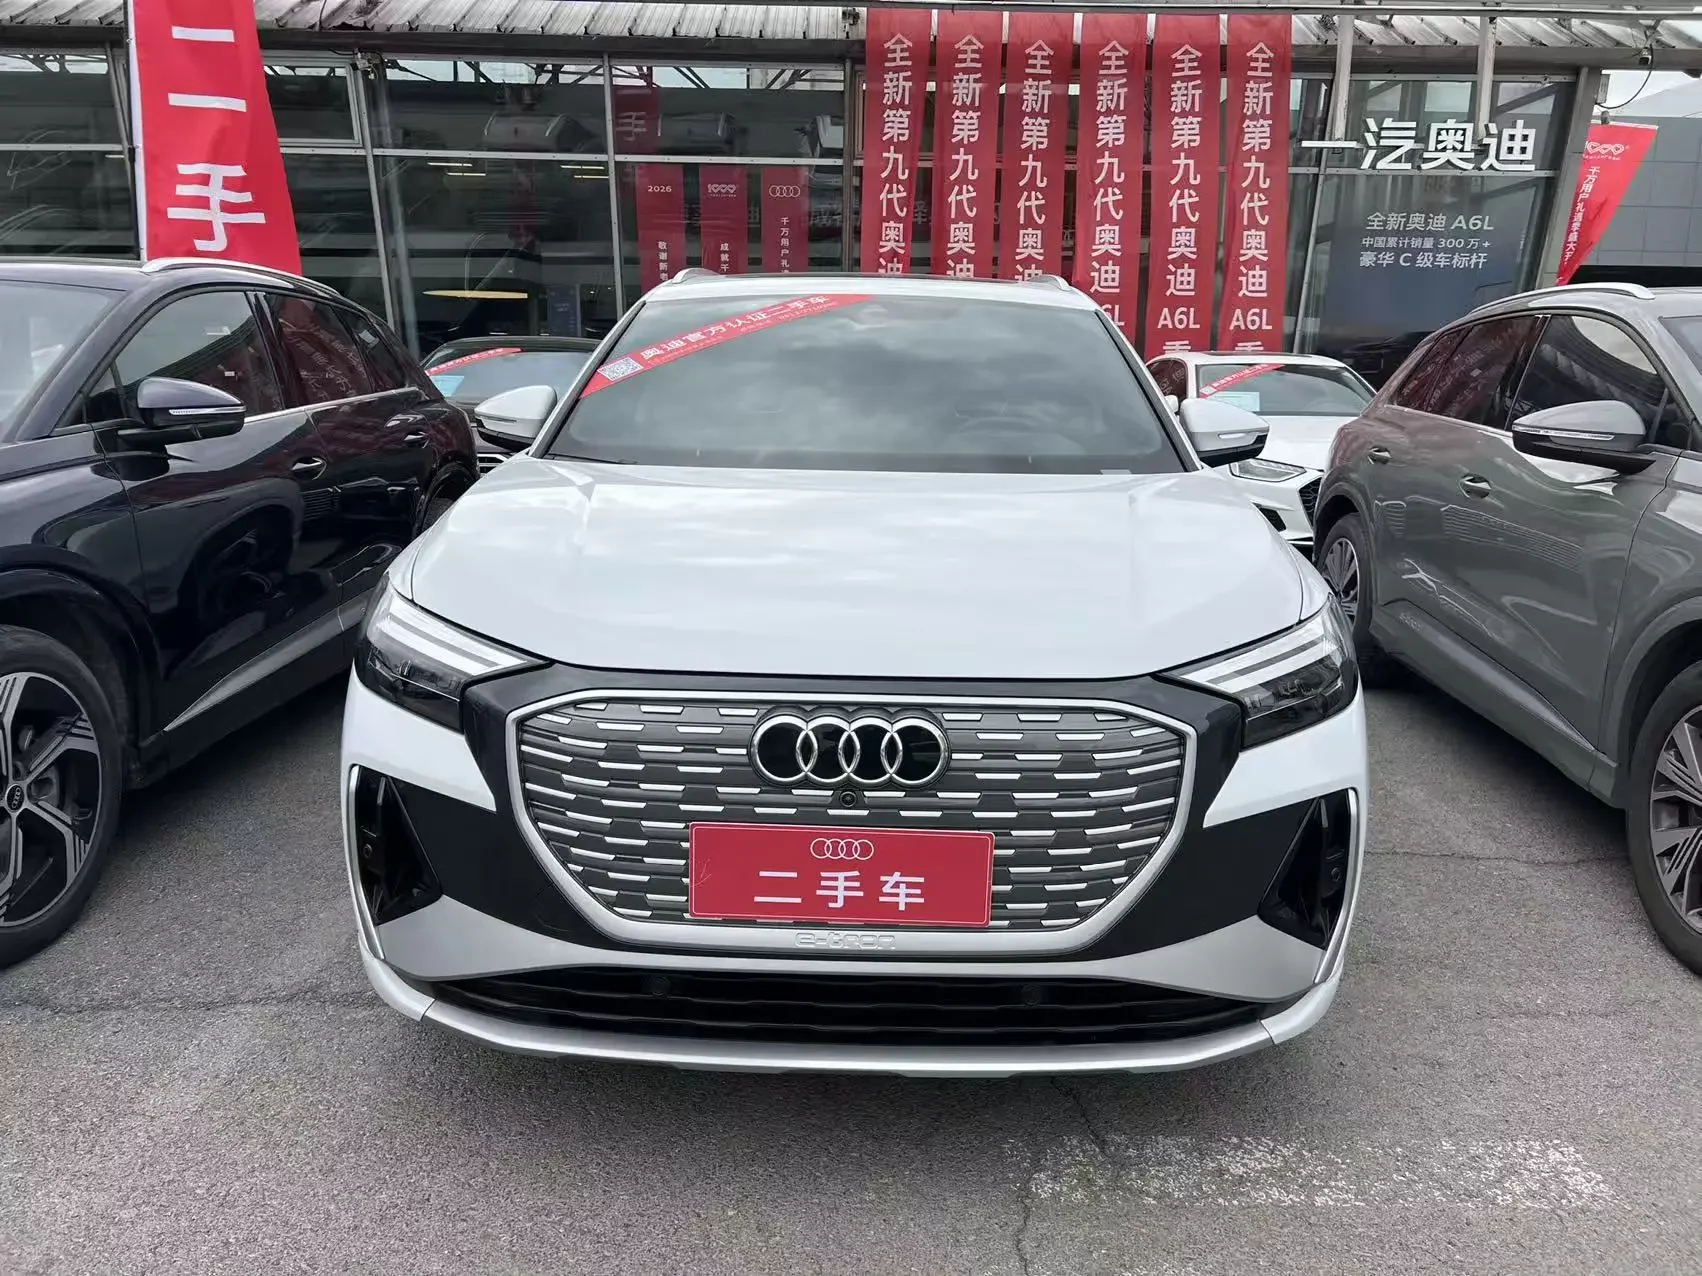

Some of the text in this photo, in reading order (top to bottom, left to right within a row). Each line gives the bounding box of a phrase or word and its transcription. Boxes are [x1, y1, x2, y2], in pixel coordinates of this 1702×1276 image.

[167, 26, 266, 252] 二手
[1301, 117, 1537, 172] 一汽奥迪
[1090, 40, 1129, 294] 全新第九代奥迪
[1165, 44, 1203, 297] 全新第九代奥迪
[1238, 42, 1275, 298] 全新第九代奥迪
[647, 185, 673, 193] 2026
[1365, 212, 1494, 231] 全新奥迪 A6L
[780, 217, 790, 273] 千万用户礼
[1362, 236, 1435, 249] 中国累计销量
[1437, 238, 1464, 248] 300
[720, 243, 730, 272] 成就千
[1359, 252, 1488, 269] 豪华 C 级车标杆
[1157, 307, 1201, 329] A6L
[1229, 308, 1273, 331] A6L
[753, 871, 925, 911] 二手车
[794, 932, 897, 950] e-tron
